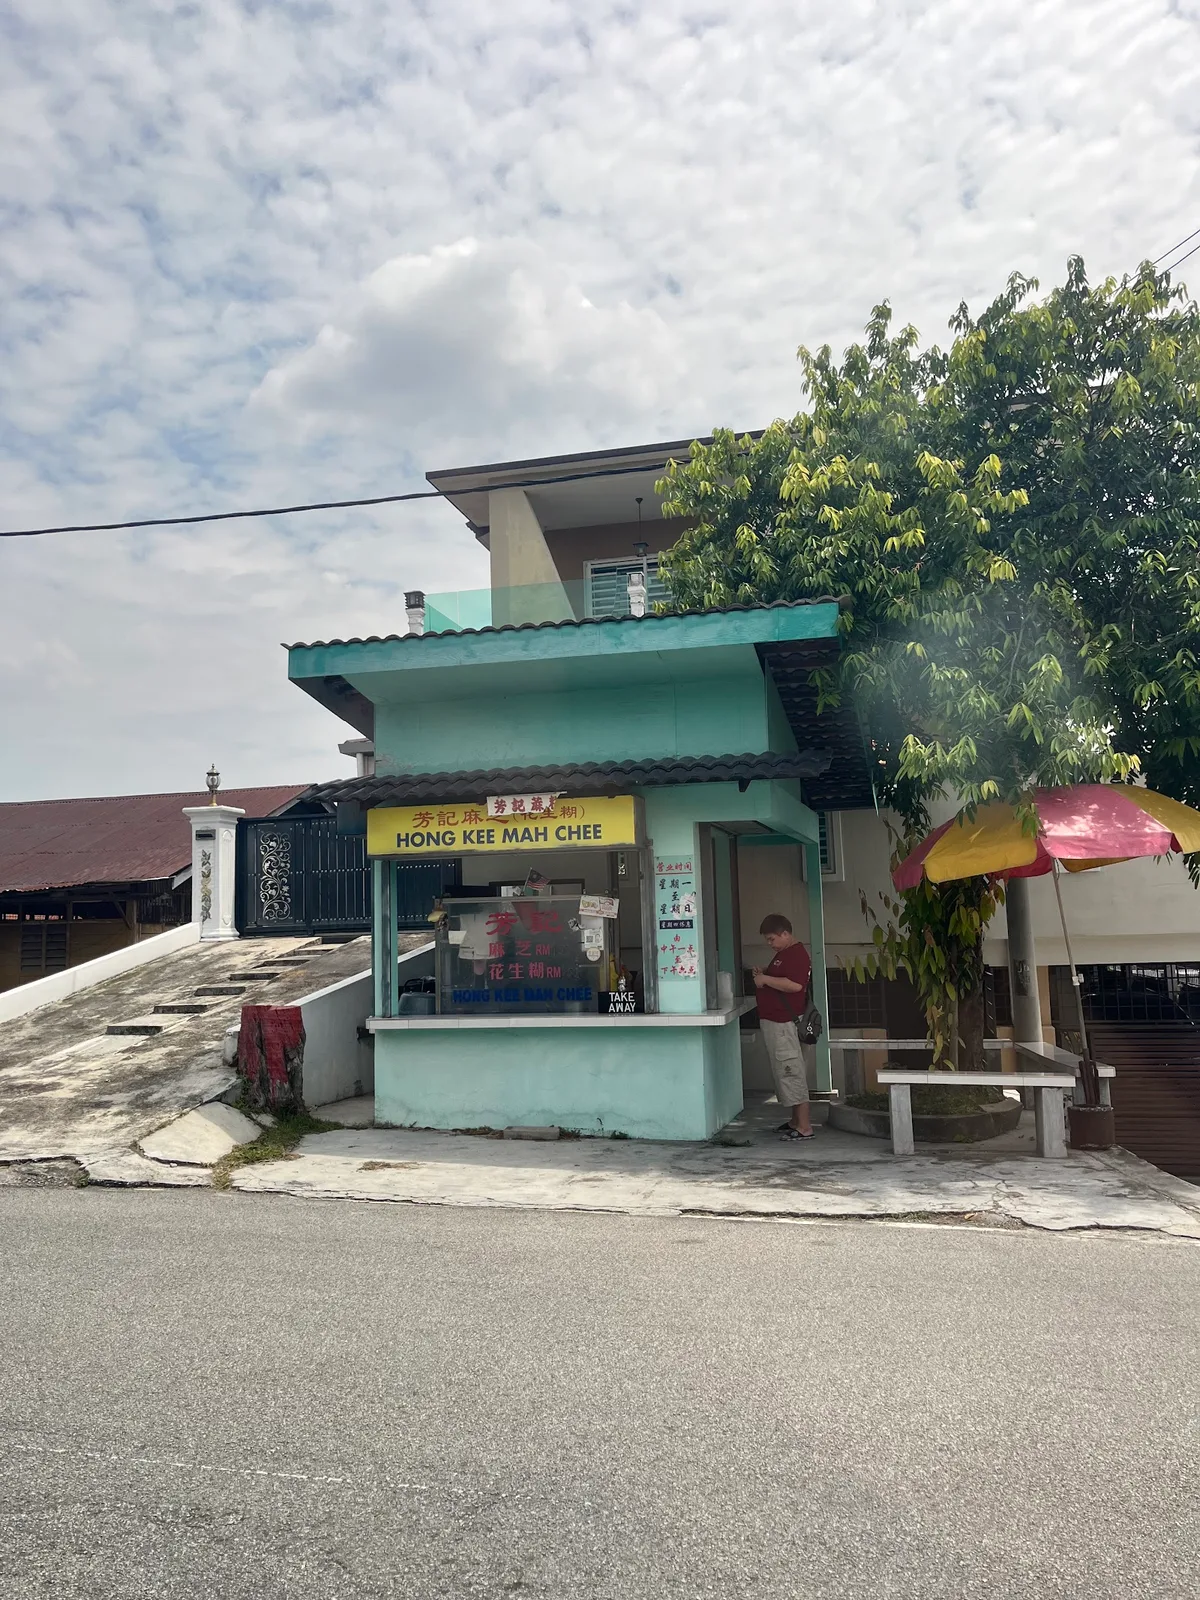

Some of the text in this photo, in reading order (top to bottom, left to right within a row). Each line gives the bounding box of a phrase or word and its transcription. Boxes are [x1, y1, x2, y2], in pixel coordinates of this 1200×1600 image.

[396, 824, 602, 847] HONG KEE MAH CHEE
[657, 861, 692, 872] 营业时间
[659, 878, 692, 890] 星期一
[671, 891, 680, 901] 至
[660, 903, 692, 914] 星期日
[535, 944, 551, 956] RM
[488, 962, 545, 980] 花生糊
[546, 966, 562, 978] RM
[453, 987, 592, 1003] HONG KEE MAH CHEE
[608, 992, 635, 1002] TAKE
[608, 1003, 636, 1013] AWAY
